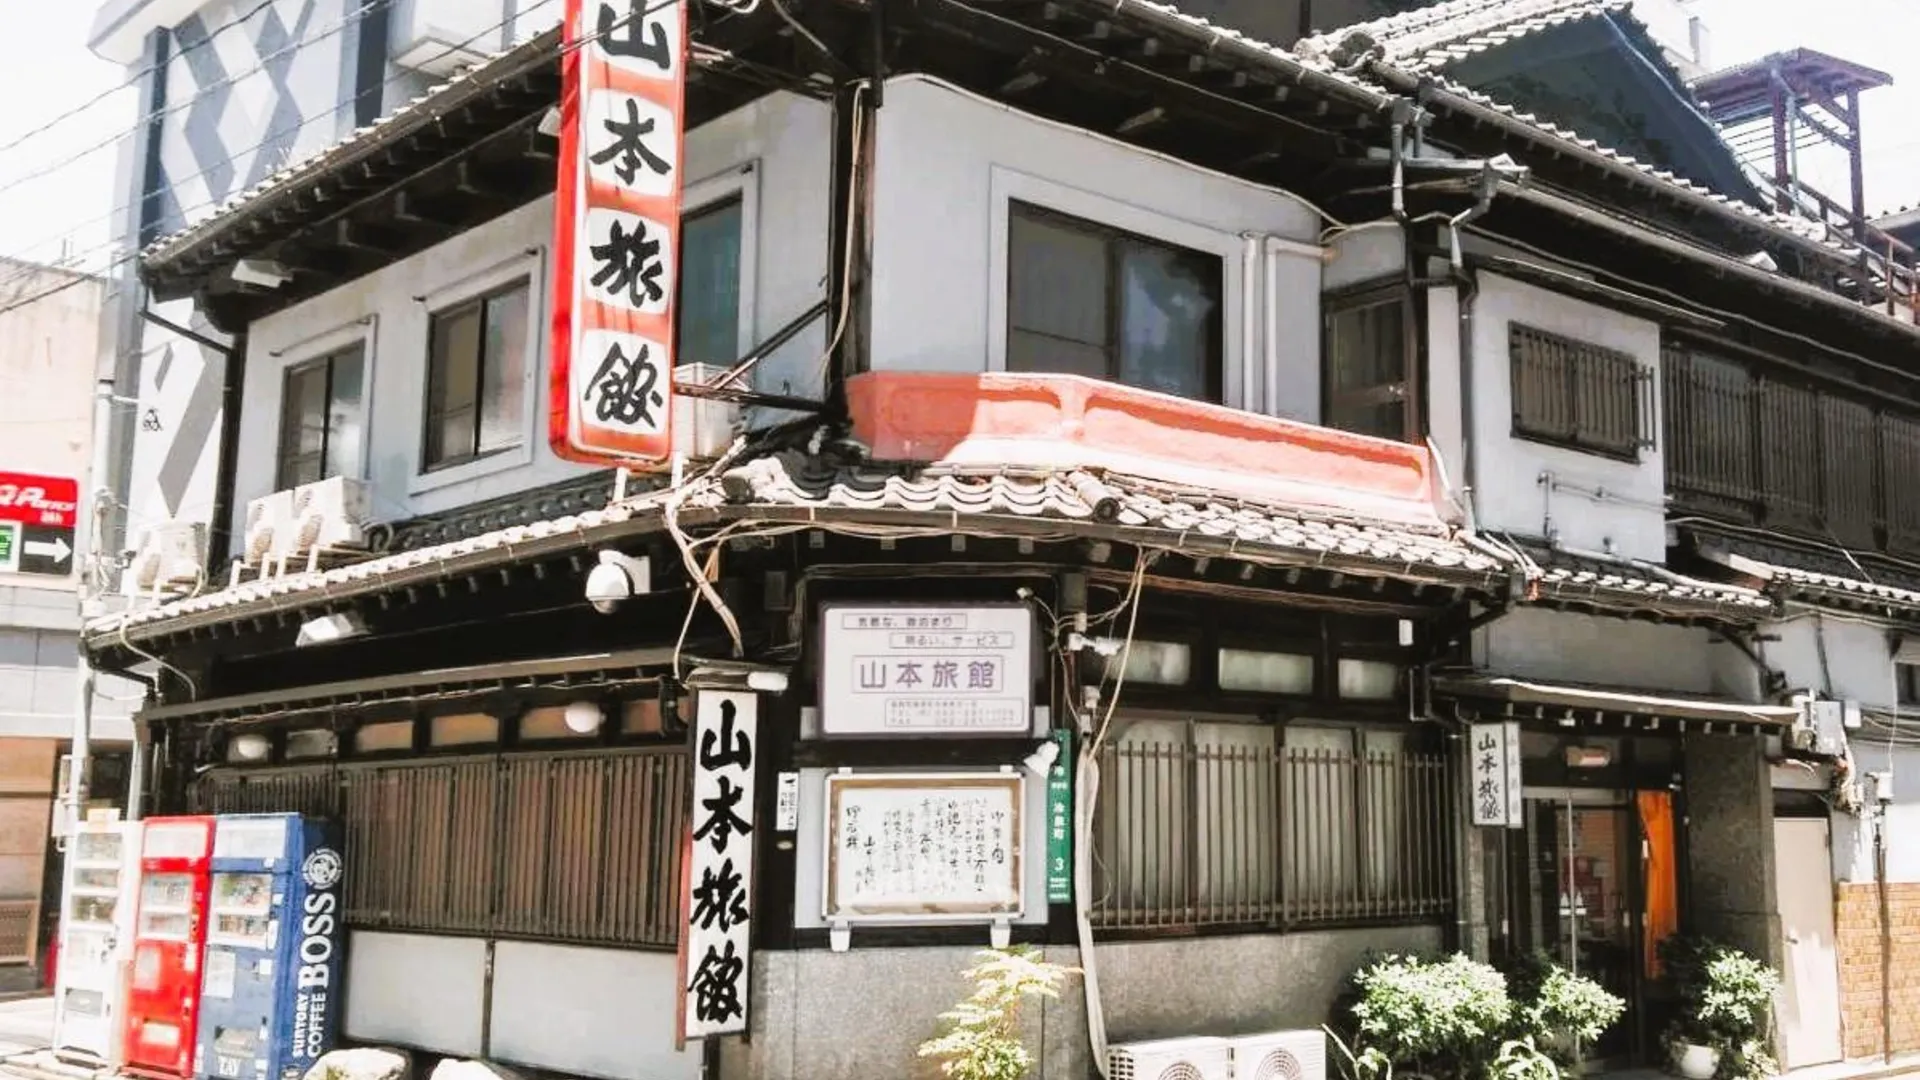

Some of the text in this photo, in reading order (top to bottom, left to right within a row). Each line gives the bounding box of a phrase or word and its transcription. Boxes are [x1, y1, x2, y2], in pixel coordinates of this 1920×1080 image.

[860, 661, 995, 688] 山本旅館
[687, 699, 754, 1024] 山本旅館
[298, 892, 336, 989] BOSS
[292, 993, 309, 1058] SUNTORY
[307, 992, 327, 1058] COFFEE
